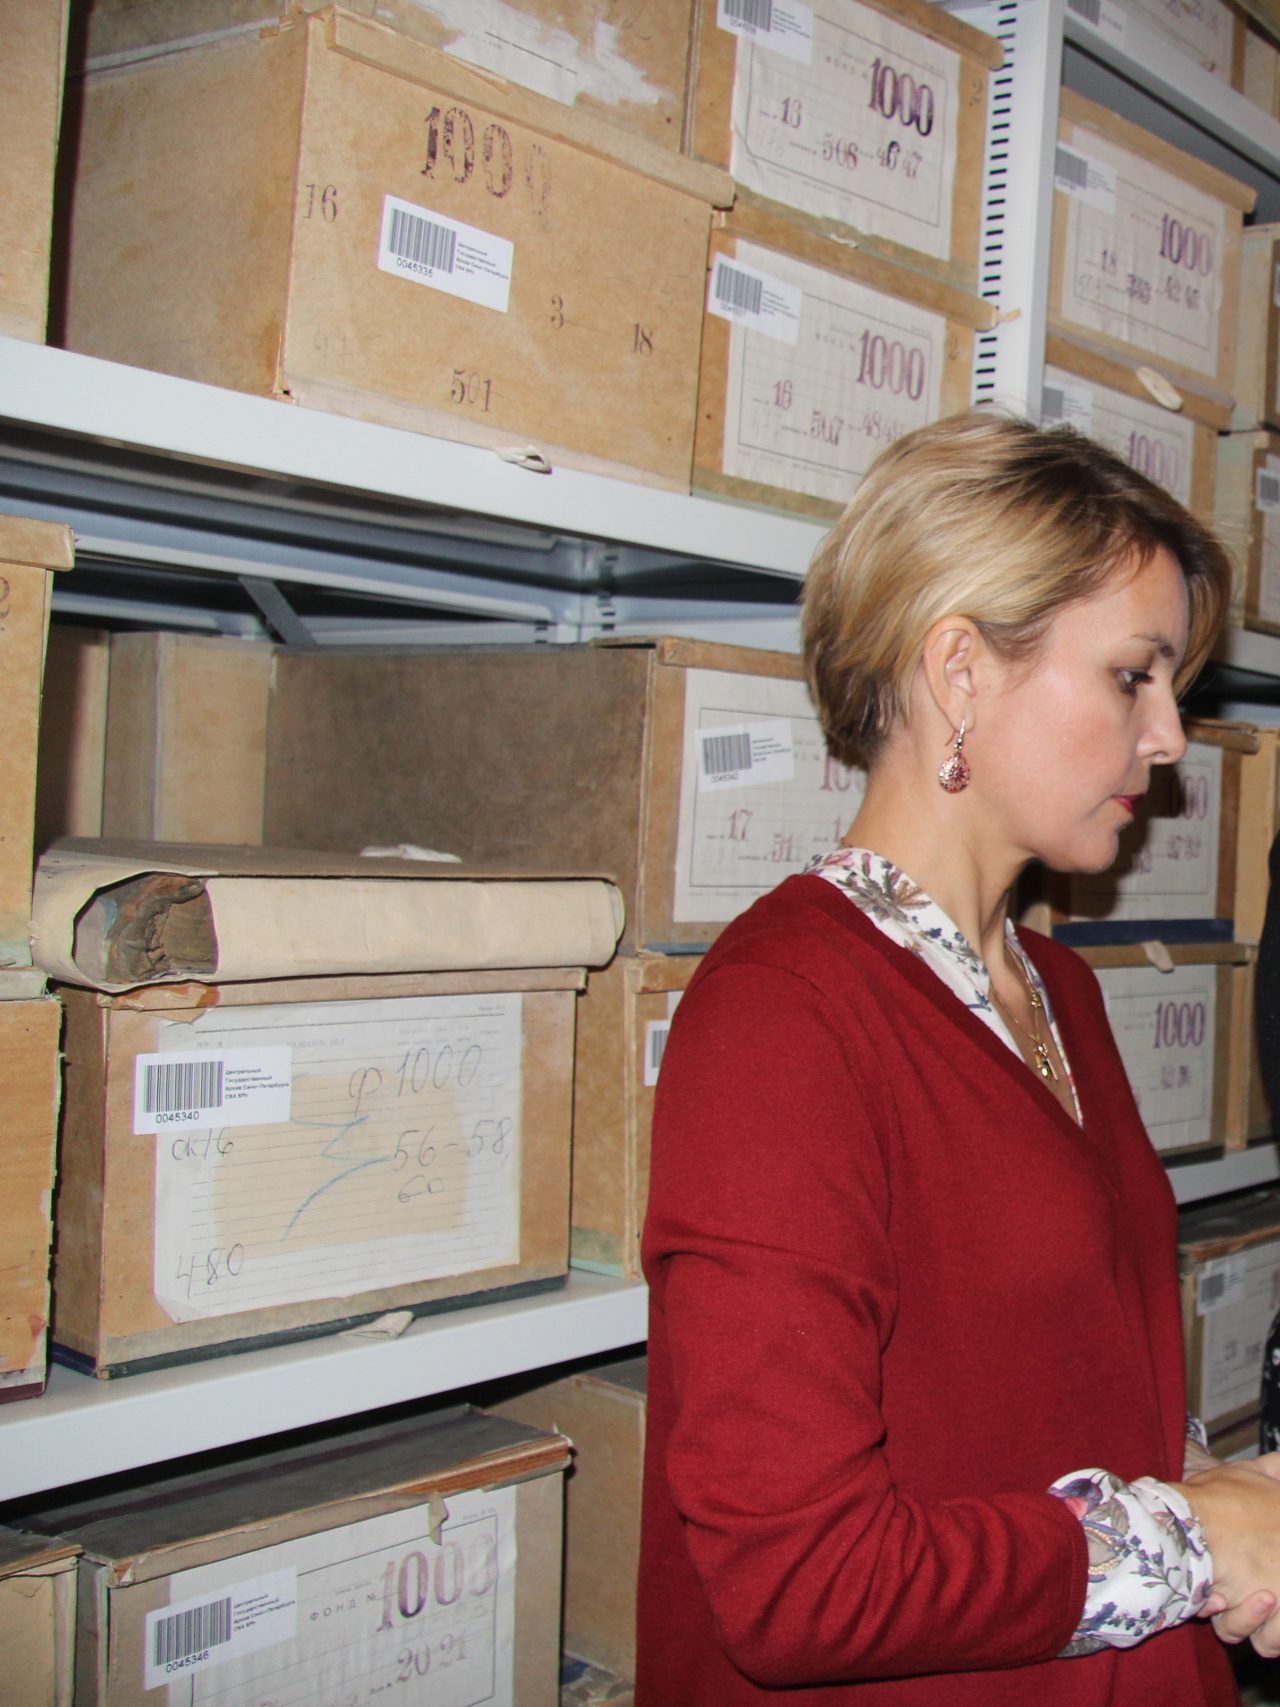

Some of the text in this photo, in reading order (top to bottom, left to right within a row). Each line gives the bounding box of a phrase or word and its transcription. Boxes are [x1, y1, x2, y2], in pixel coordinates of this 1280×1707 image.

[868, 57, 935, 137] 1000
[302, 183, 338, 223] 16
[1160, 213, 1213, 277] 1000
[396, 257, 435, 279] 0045335
[550, 294, 565, 329] 3
[631, 322, 653, 357] 18
[856, 329, 925, 401] 1000
[450, 368, 493, 413] 501
[728, 808, 753, 842] 17
[1154, 1002, 1206, 1049] 1000
[396, 1045, 483, 1097] 1000
[155, 1111, 201, 1124] 0045340
[165, 1651, 210, 1674] 0045346
